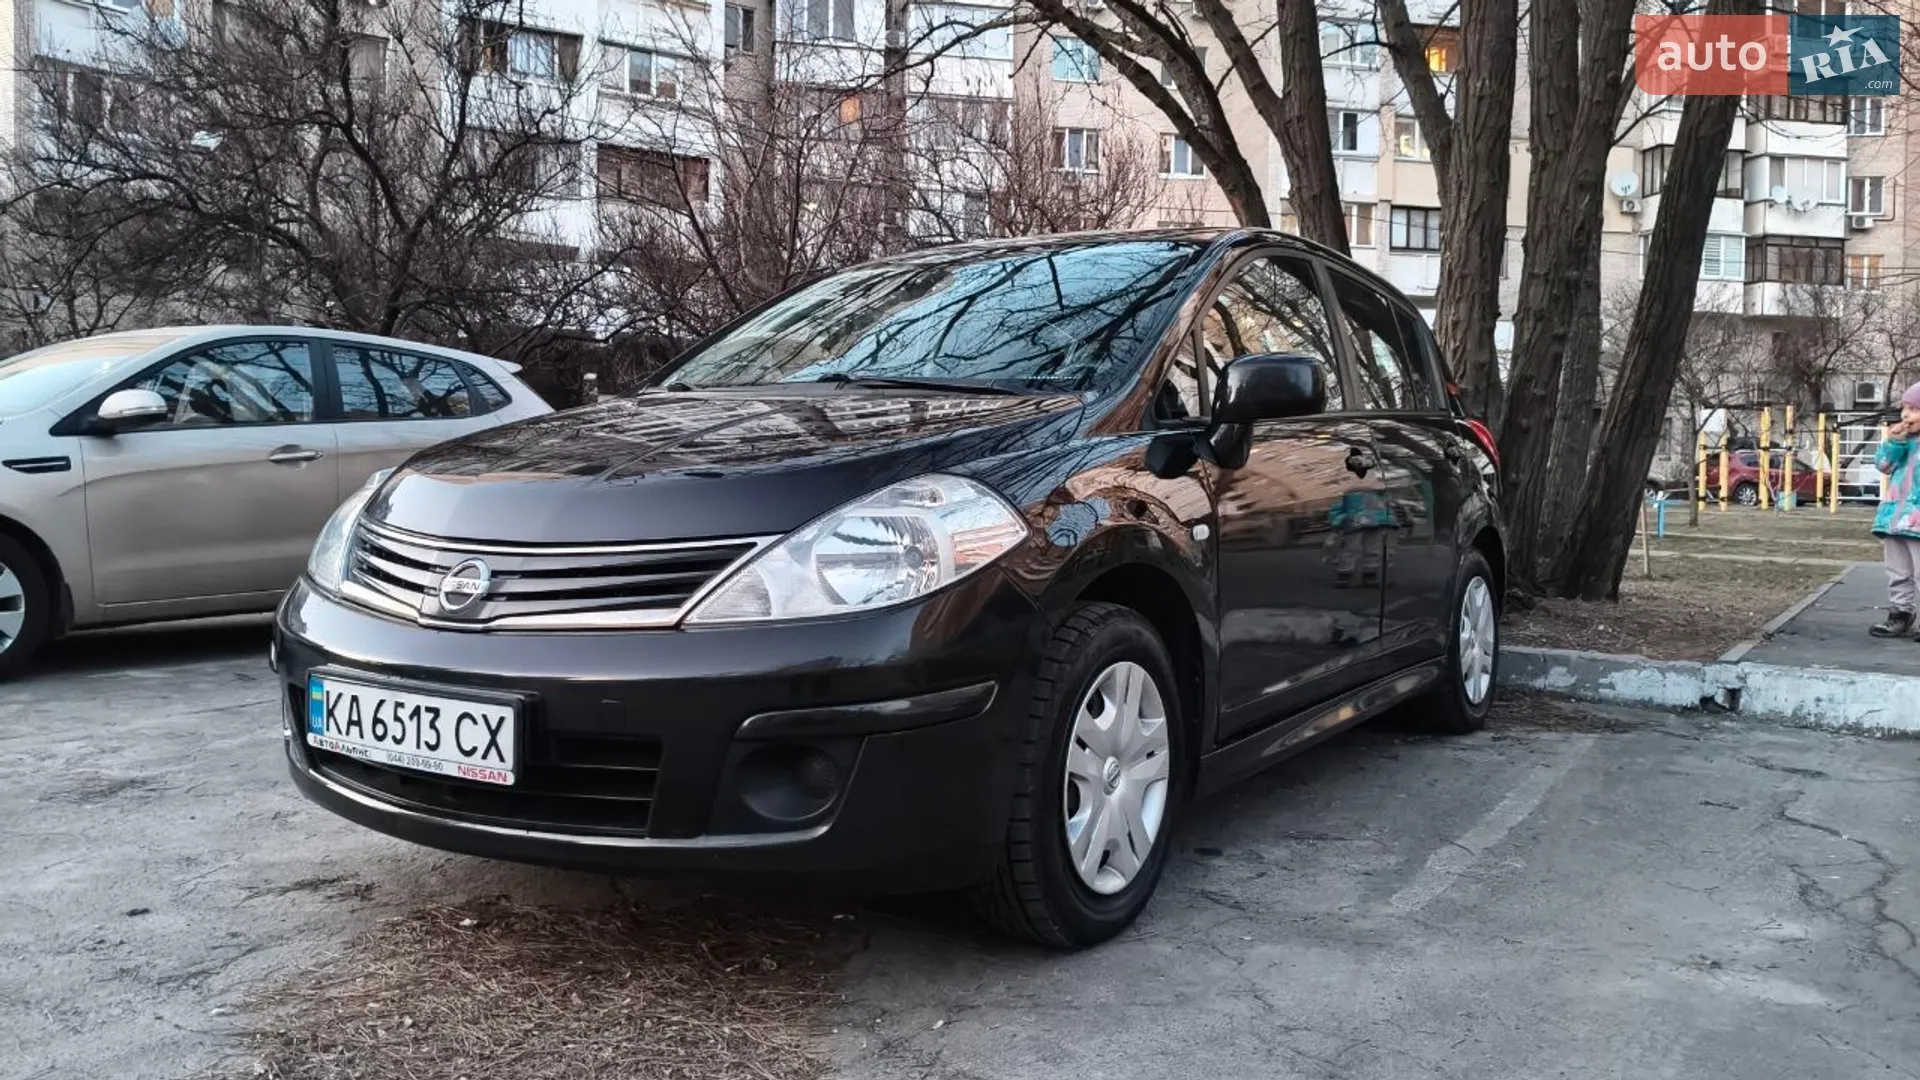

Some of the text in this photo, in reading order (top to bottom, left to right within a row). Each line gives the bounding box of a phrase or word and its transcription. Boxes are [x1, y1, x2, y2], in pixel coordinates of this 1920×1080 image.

[325, 690, 507, 764] KA 6513 CX
[457, 765, 508, 783] NISSAN
